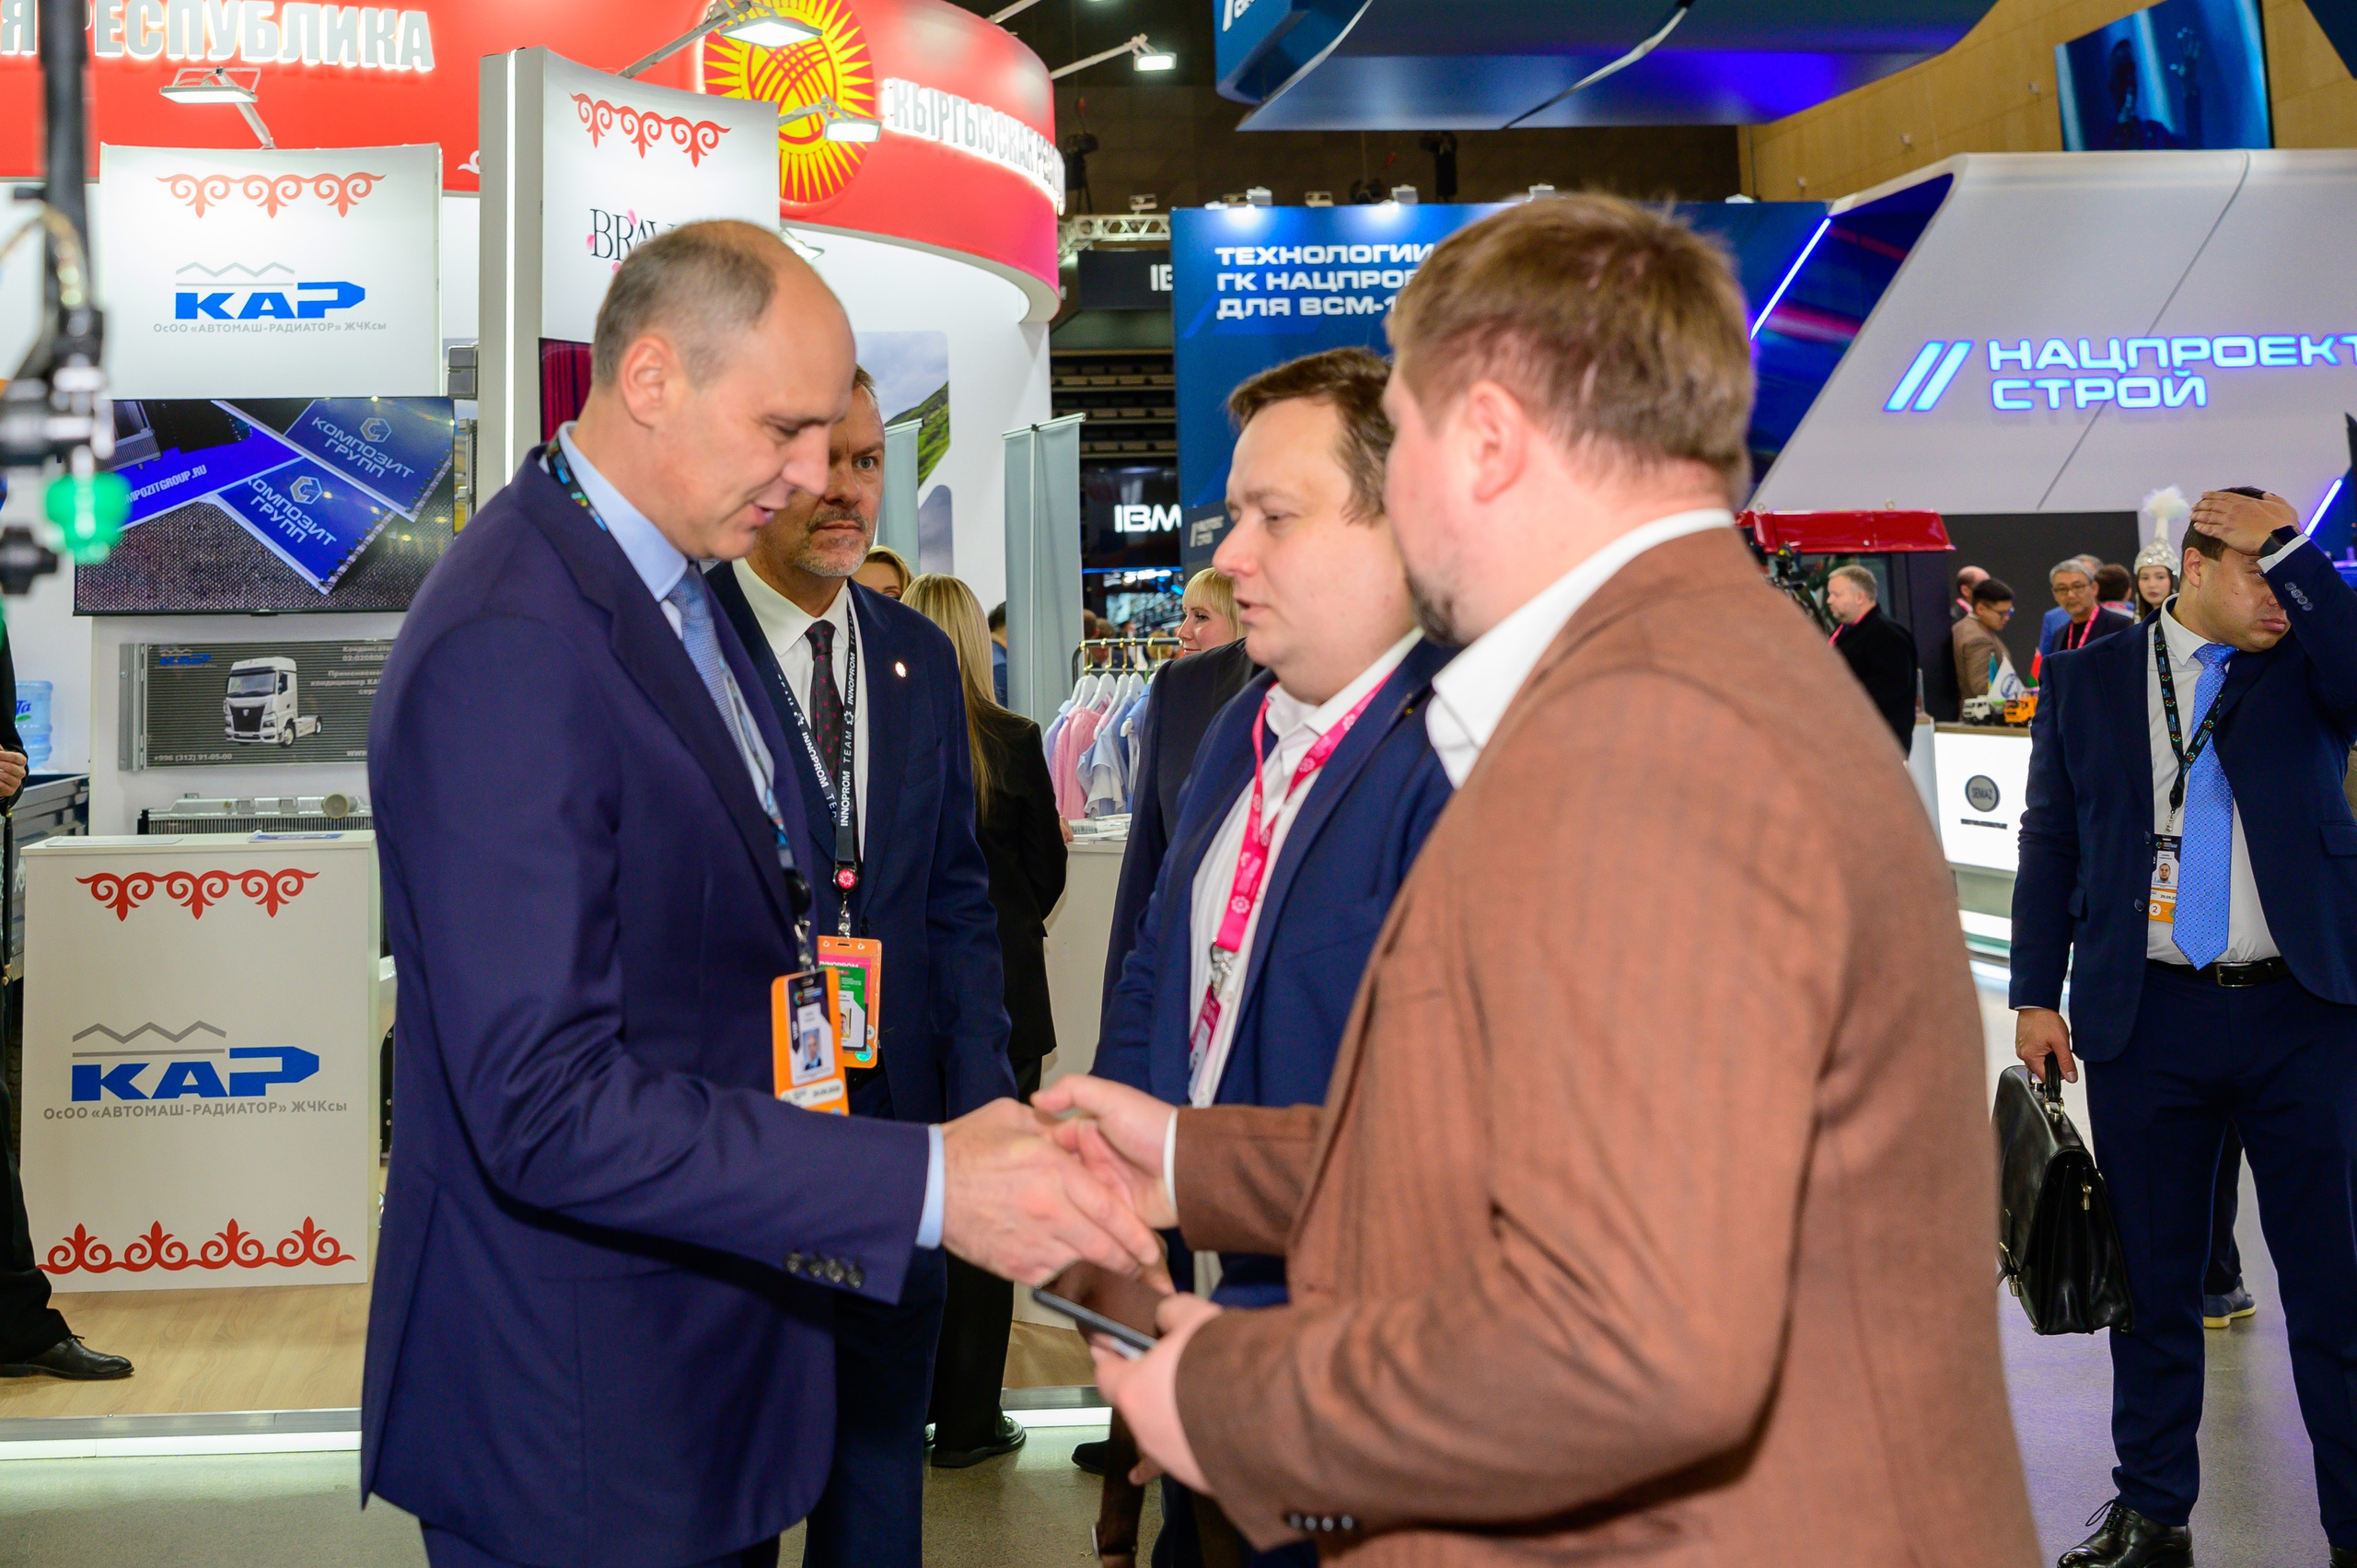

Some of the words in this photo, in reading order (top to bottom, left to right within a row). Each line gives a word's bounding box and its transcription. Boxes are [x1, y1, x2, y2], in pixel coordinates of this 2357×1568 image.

[85, 0, 435, 71] ЕСПУБЛИКА
[1214, 243, 1436, 266] ТЕХНОЛОГИИ
[1217, 273, 1258, 292] ГК
[154, 323, 188, 333] ОсОО
[191, 321, 342, 333] «АВТОМАШ-РАДИАТОР»
[344, 321, 387, 331] ЖЧКсы
[1216, 297, 1292, 320] ДЛЯ
[1299, 295, 1398, 317] ВСМ-1
[1991, 368, 2208, 410] СТРОЙ
[310, 416, 414, 479] КОМПОЗИТ
[323, 436, 387, 479] ГРУПП
[250, 494, 308, 544] ГРУПП
[1114, 504, 1182, 533] IBM
[847, 652, 856, 705] INNOPROM
[802, 731, 830, 788] INNOPROM
[843, 730, 853, 763] TEAM
[841, 771, 851, 827] INNOPROM
[43, 1108, 87, 1120] ОсОО
[91, 1101, 287, 1119] «АВТОМАШ-РАДИАТОР»
[291, 1099, 347, 1113] ЖЧКсы
